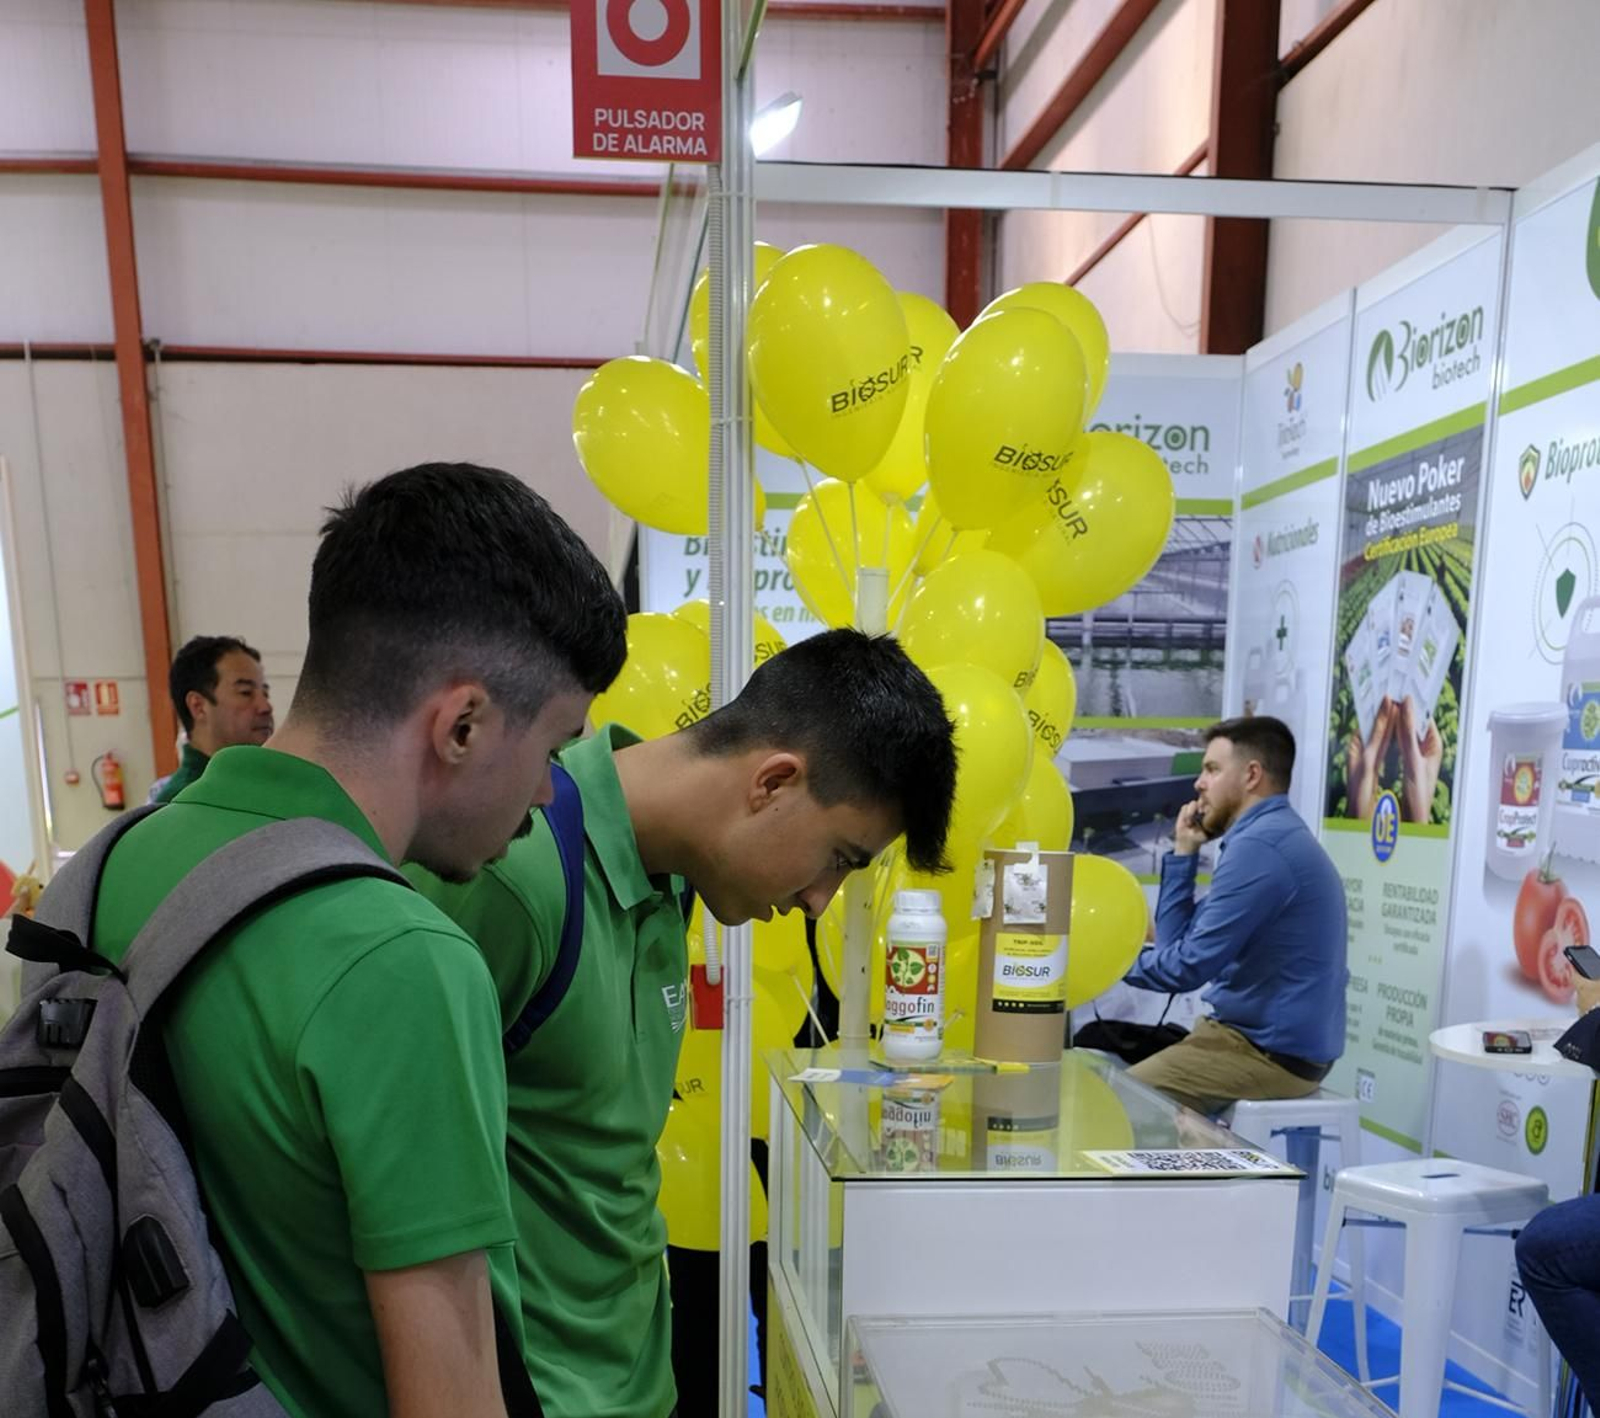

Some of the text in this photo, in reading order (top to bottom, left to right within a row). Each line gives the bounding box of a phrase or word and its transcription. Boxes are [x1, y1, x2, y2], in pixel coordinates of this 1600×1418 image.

[594, 108, 705, 131] PULSADOR
[592, 133, 708, 156] DE ALARMA
[1396, 305, 1484, 392] Biorizon
[1432, 345, 1481, 390] biotech
[831, 354, 908, 413] BIOSUR
[1367, 454, 1465, 512] Nuevo Poker
[1545, 437, 1600, 484] Biopro
[1003, 964, 1051, 977] BIOSUR
